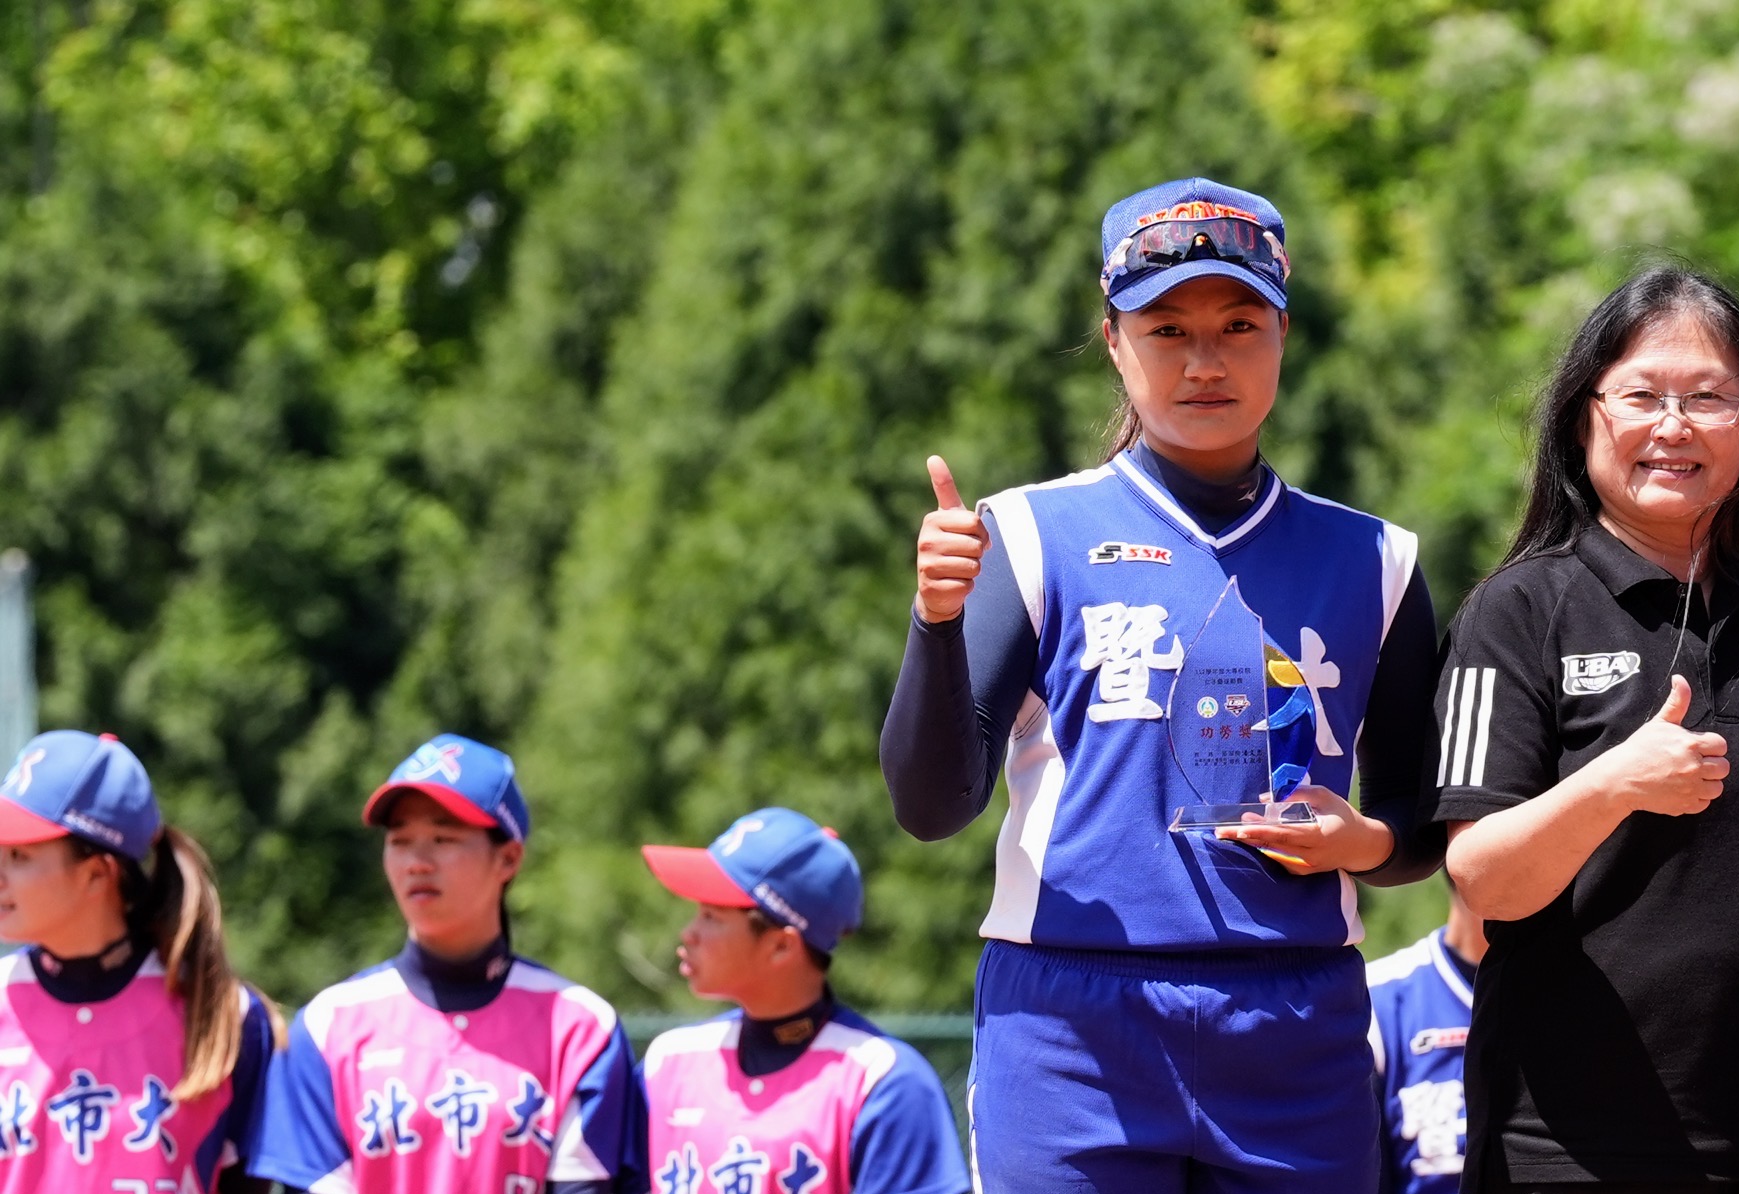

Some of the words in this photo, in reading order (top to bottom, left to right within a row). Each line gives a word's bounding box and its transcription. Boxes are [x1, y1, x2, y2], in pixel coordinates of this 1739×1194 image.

[1126, 547, 1168, 561] SSK
[1569, 655, 1631, 677] UBA
[1200, 723, 1252, 740] 功勞獎
[354, 1068, 555, 1160] 北市大
